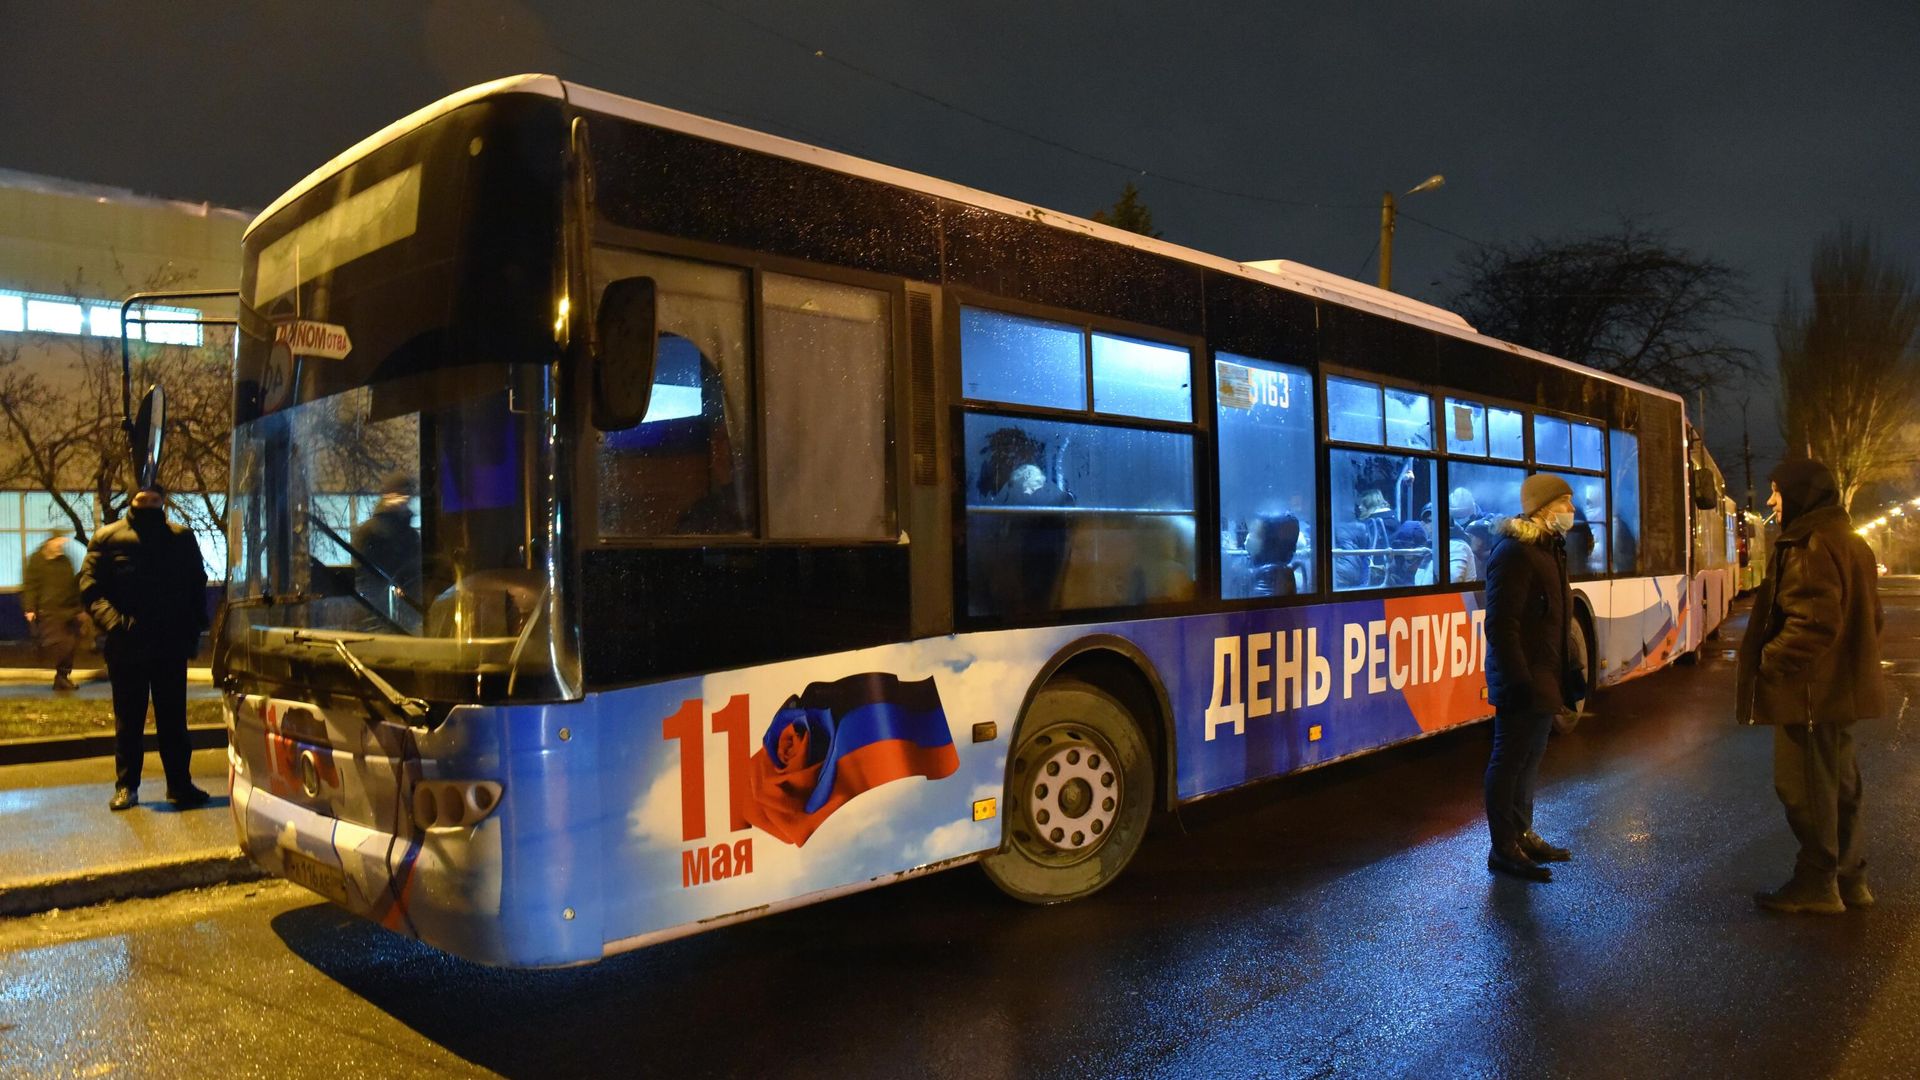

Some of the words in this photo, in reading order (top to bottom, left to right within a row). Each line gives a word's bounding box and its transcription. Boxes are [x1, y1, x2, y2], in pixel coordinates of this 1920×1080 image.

[1249, 368, 1290, 409] 5163
[1205, 627, 1332, 742] ДЕНЬ
[662, 692, 753, 842] 11
[682, 838, 754, 889] мая
